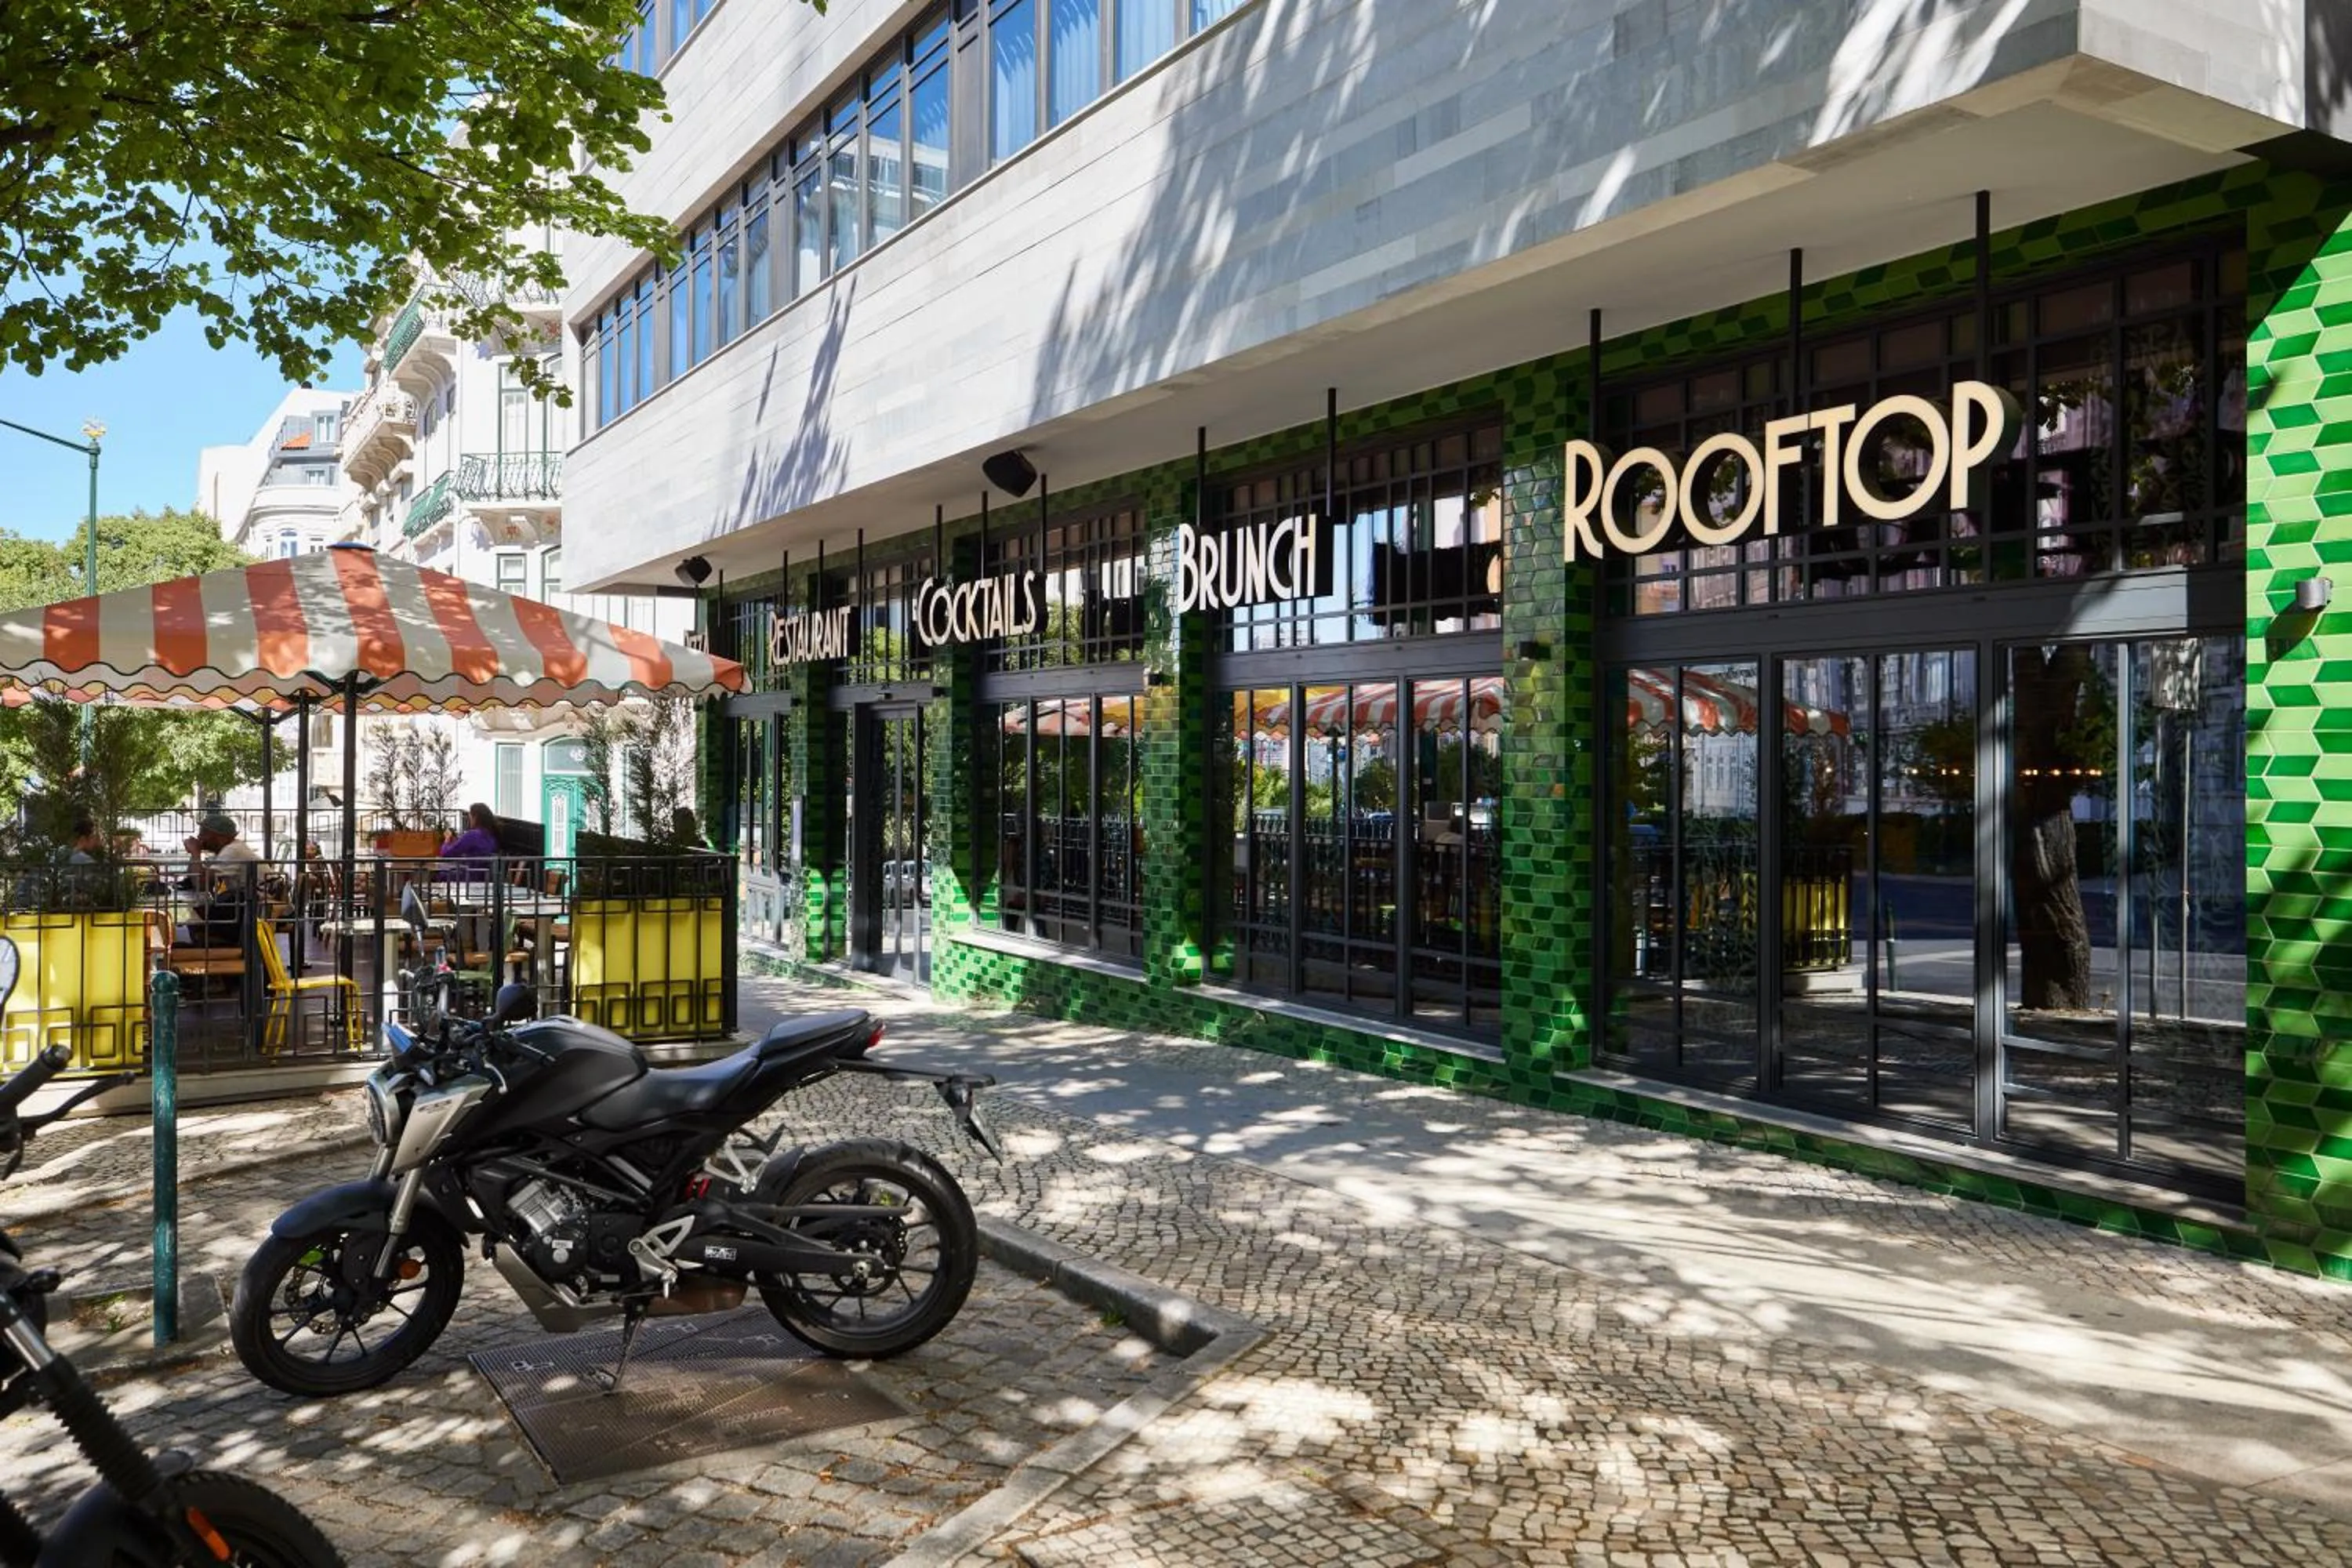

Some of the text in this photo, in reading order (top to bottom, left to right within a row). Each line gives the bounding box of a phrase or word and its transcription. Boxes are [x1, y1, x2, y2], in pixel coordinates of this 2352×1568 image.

[1565, 380, 2005, 562] ROOFTOP
[1177, 514, 1316, 614] BRUNCH
[768, 605, 851, 666] RESTAURANT
[918, 570, 1036, 647] COCKTAILS
